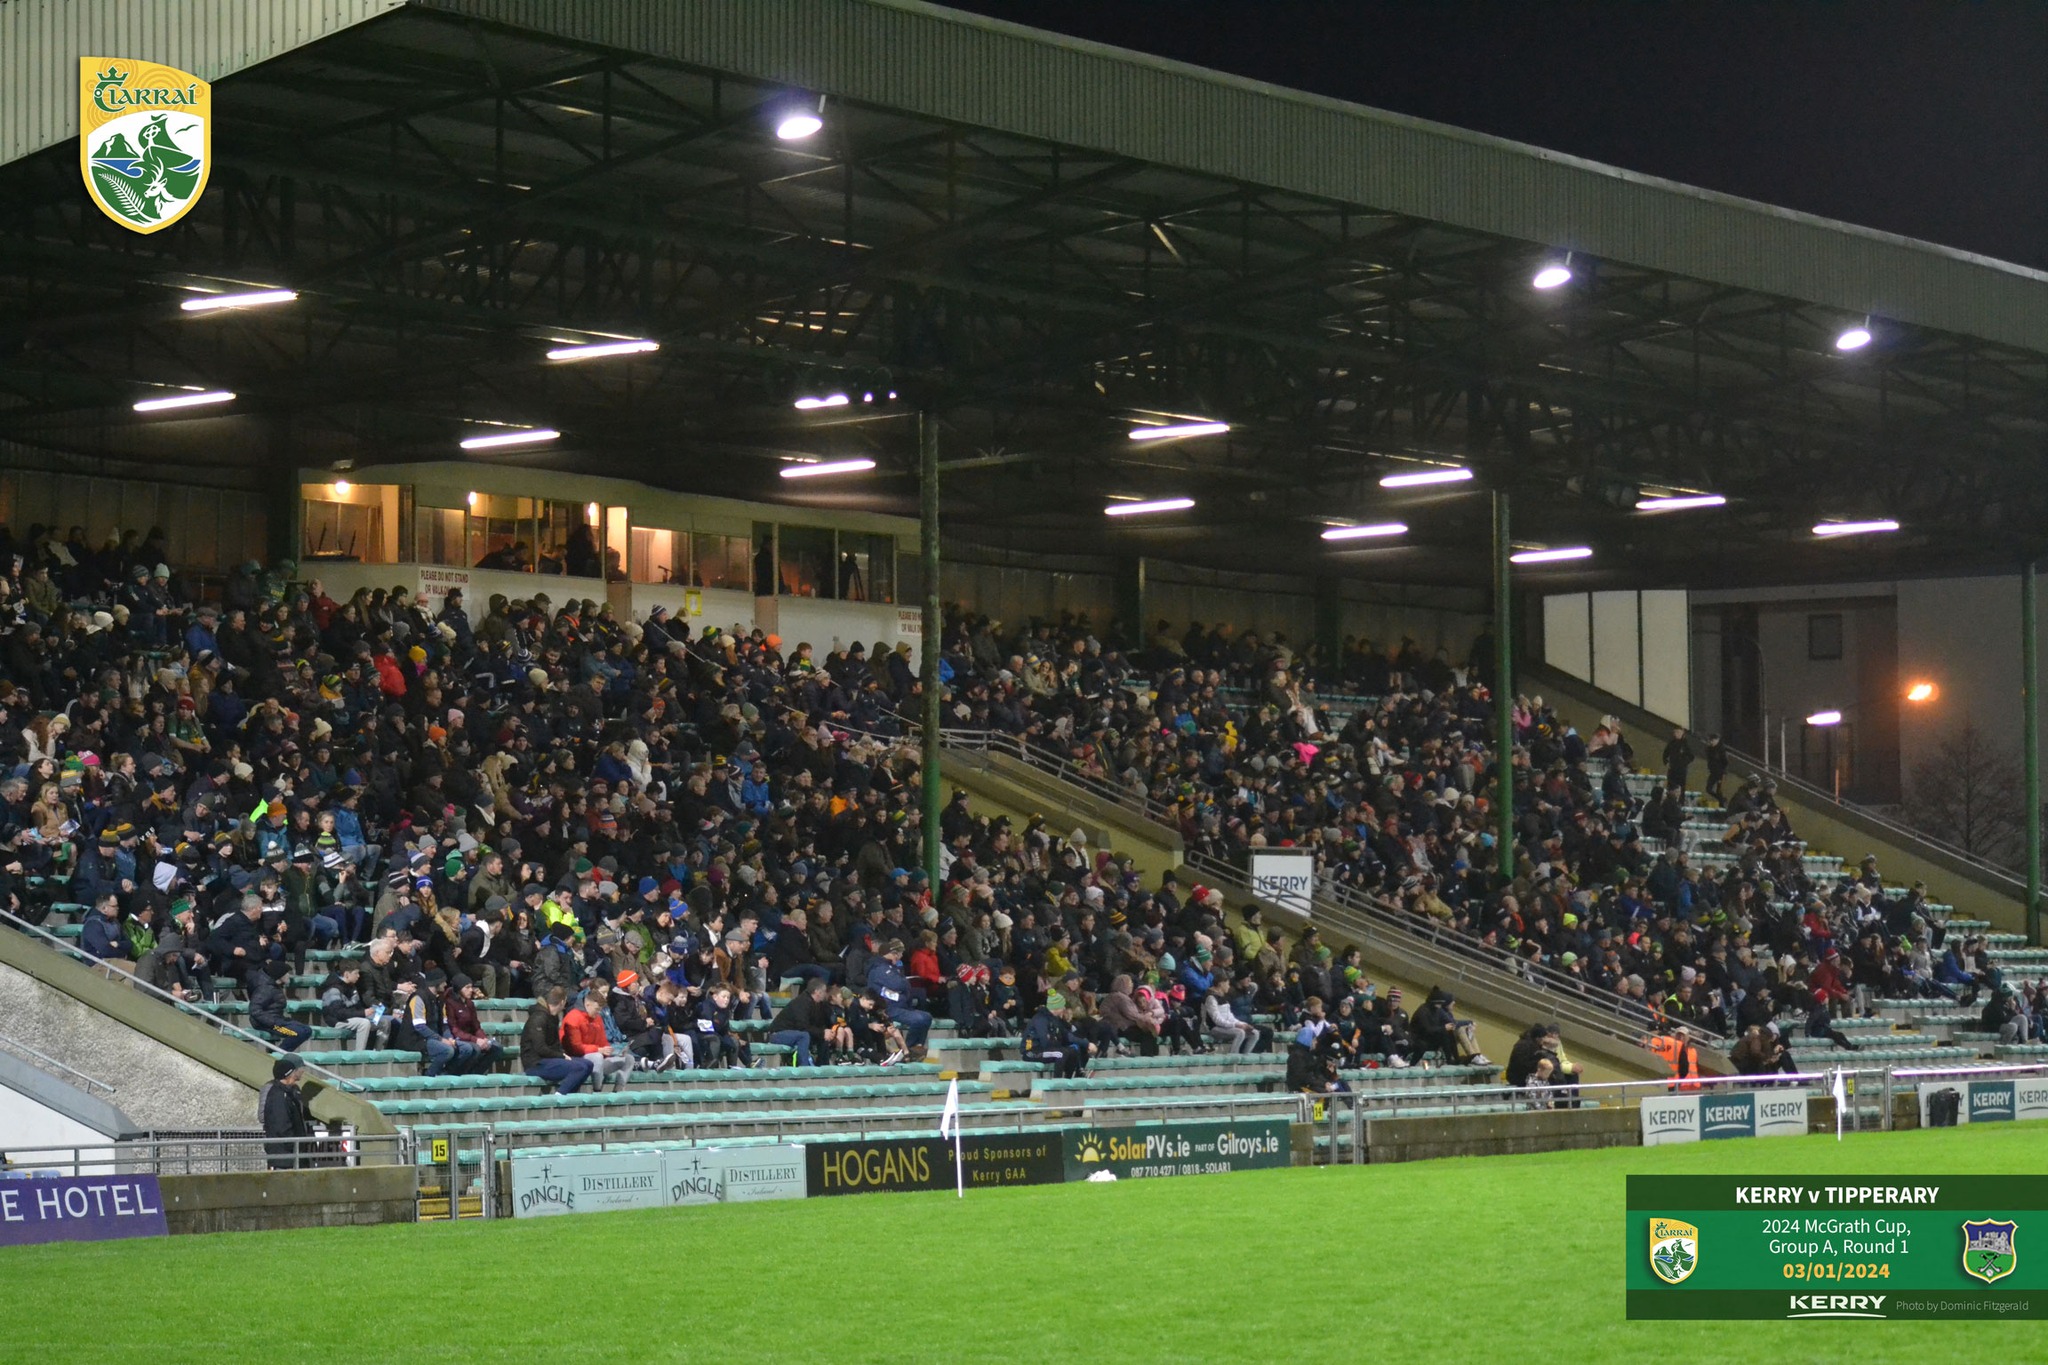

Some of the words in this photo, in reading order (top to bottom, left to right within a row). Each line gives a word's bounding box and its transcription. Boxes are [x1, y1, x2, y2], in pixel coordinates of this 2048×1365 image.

[421, 569, 437, 581] PLEASE
[438, 571, 444, 582] DO
[445, 571, 454, 583] NOT
[455, 573, 468, 584] STAND
[425, 584, 431, 594] OR
[432, 584, 443, 596] WALK
[1258, 875, 1308, 891] KERRY
[1973, 1091, 2011, 1107] KERRY
[2018, 1090, 2048, 1104] KERR
[1315, 1105, 1322, 1117] 14
[1649, 1108, 1695, 1126] KERRY
[1705, 1104, 1750, 1122] KERRY
[1760, 1101, 1802, 1118] KERRY
[435, 1145, 446, 1157] 15
[948, 1148, 979, 1161] Poud
[983, 1147, 1032, 1161] Sponsors
[1036, 1145, 1046, 1157] of
[1109, 1133, 1190, 1161] SolarPVs.ie
[1195, 1143, 1207, 1152] PART
[1208, 1143, 1215, 1152] OF
[1217, 1129, 1279, 1158] Gilroys.ie
[729, 1167, 797, 1183] DISTILLERY
[823, 1146, 930, 1188] HOGANS
[972, 1169, 1000, 1183] Kerry
[1005, 1167, 1026, 1180] GAA
[1131, 1166, 1144, 1178] 087
[1145, 1166, 1158, 1177] 710
[1159, 1165, 1176, 1177] 4271
[1182, 1163, 1200, 1175] 0818
[582, 1175, 654, 1192] DISTILLERY
[672, 1176, 722, 1202] DINGLE
[0, 1189, 24, 1221] E
[36, 1184, 157, 1220] HOTEL
[520, 1184, 575, 1212] DINGLE
